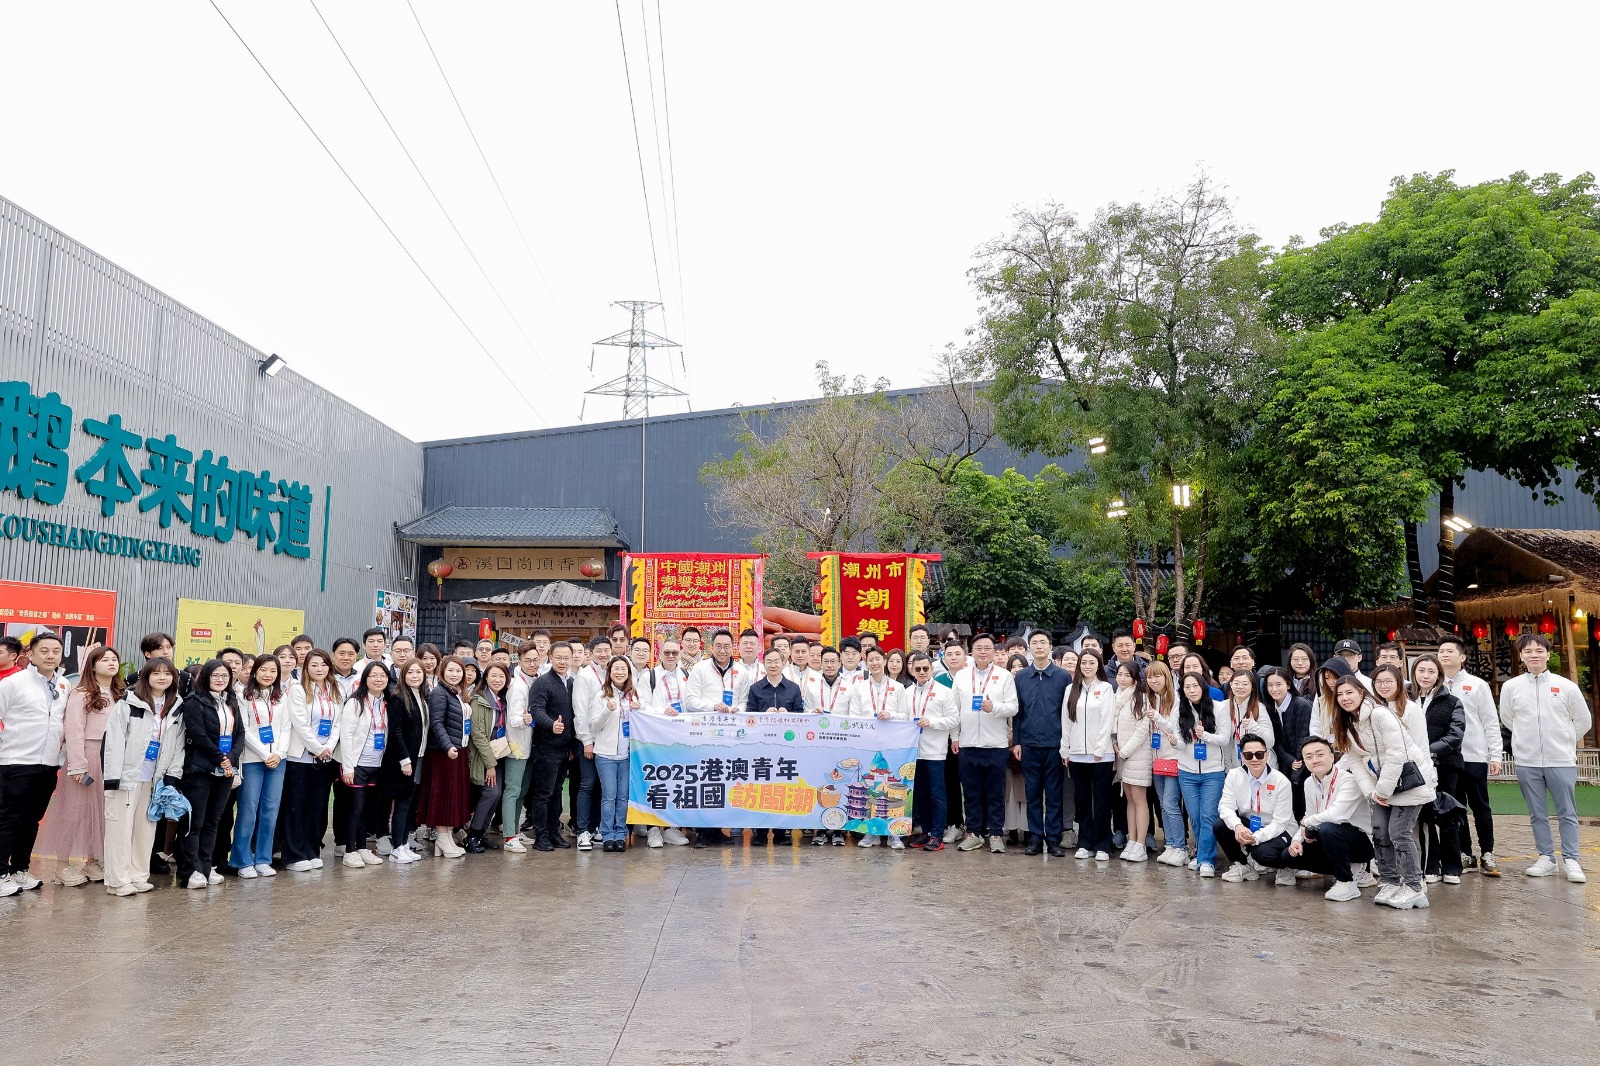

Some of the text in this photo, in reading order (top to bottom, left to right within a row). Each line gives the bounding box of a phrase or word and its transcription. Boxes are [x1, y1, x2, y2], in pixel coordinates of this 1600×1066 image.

[660, 559, 726, 575] 中國潮州
[842, 561, 905, 580] 潮州市
[642, 757, 800, 782] 2025港澳青年
[646, 782, 814, 813] 看祖國 訪閩潮
